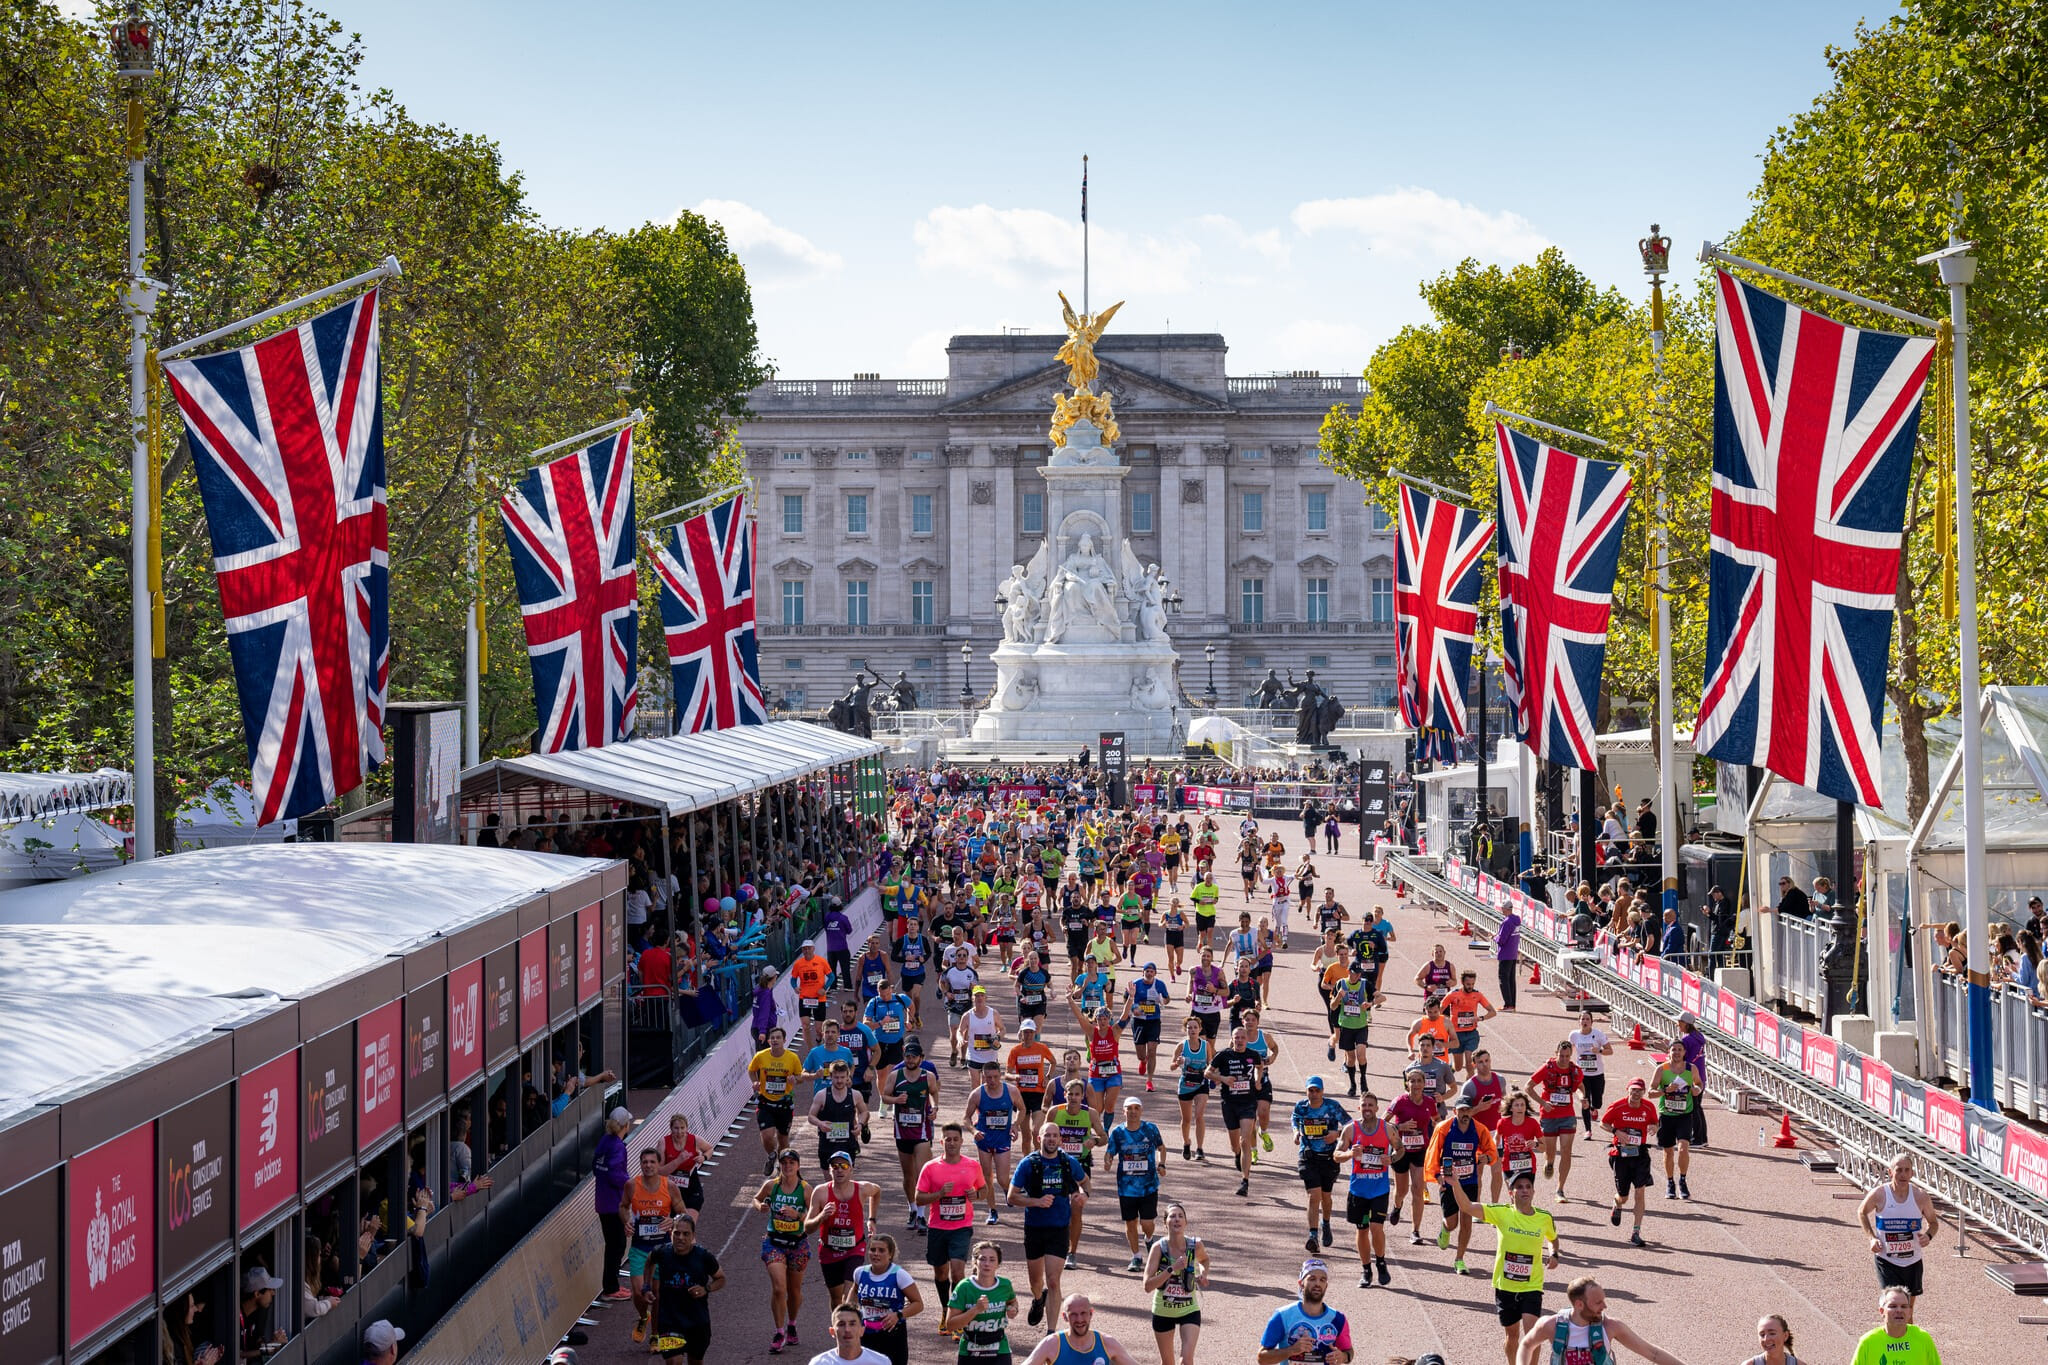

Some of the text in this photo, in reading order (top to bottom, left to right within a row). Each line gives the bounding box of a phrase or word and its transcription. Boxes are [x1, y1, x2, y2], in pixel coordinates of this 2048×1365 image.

[1105, 750, 1121, 758] 200
[452, 995, 464, 1051] tcs
[378, 1051, 389, 1068] WORLD
[410, 1023, 423, 1079] tcs
[325, 1068, 336, 1089] TATA
[378, 1065, 395, 1089] MARATHON
[325, 1084, 347, 1111] CONSULTANCY
[378, 1085, 391, 1105] MAJORS
[308, 1079, 325, 1143] tcs
[325, 1110, 340, 1134] SERVICES
[1622, 1115, 1646, 1123] CANADA
[192, 1139, 207, 1164] TATA
[1938, 1126, 1961, 1154] MARATHON
[192, 1156, 222, 1191] CONSULTANCY
[254, 1156, 282, 1190] new balance
[1127, 1161, 1143, 1169] 2741
[1511, 1160, 1530, 1168] 27249
[111, 1174, 121, 1193] THE
[169, 1157, 191, 1231] tcs
[2019, 1167, 2048, 1198] MARATHON
[192, 1188, 212, 1218] SERVICES
[776, 1194, 798, 1204] KATY
[943, 1205, 964, 1214] 37785
[111, 1195, 137, 1234] ROYAL
[1508, 1226, 1541, 1238] mexico
[2, 1240, 22, 1270] TATA
[111, 1234, 136, 1275] PARKS
[1889, 1242, 1912, 1251] 37209
[2, 1257, 47, 1301] CONSULTANCY
[1506, 1262, 1529, 1275] 39205
[858, 1282, 898, 1299] SASKIA
[1166, 1286, 1187, 1296] 4253
[2, 1298, 31, 1336] SERVICES
[1886, 1341, 1911, 1352] MIKE
